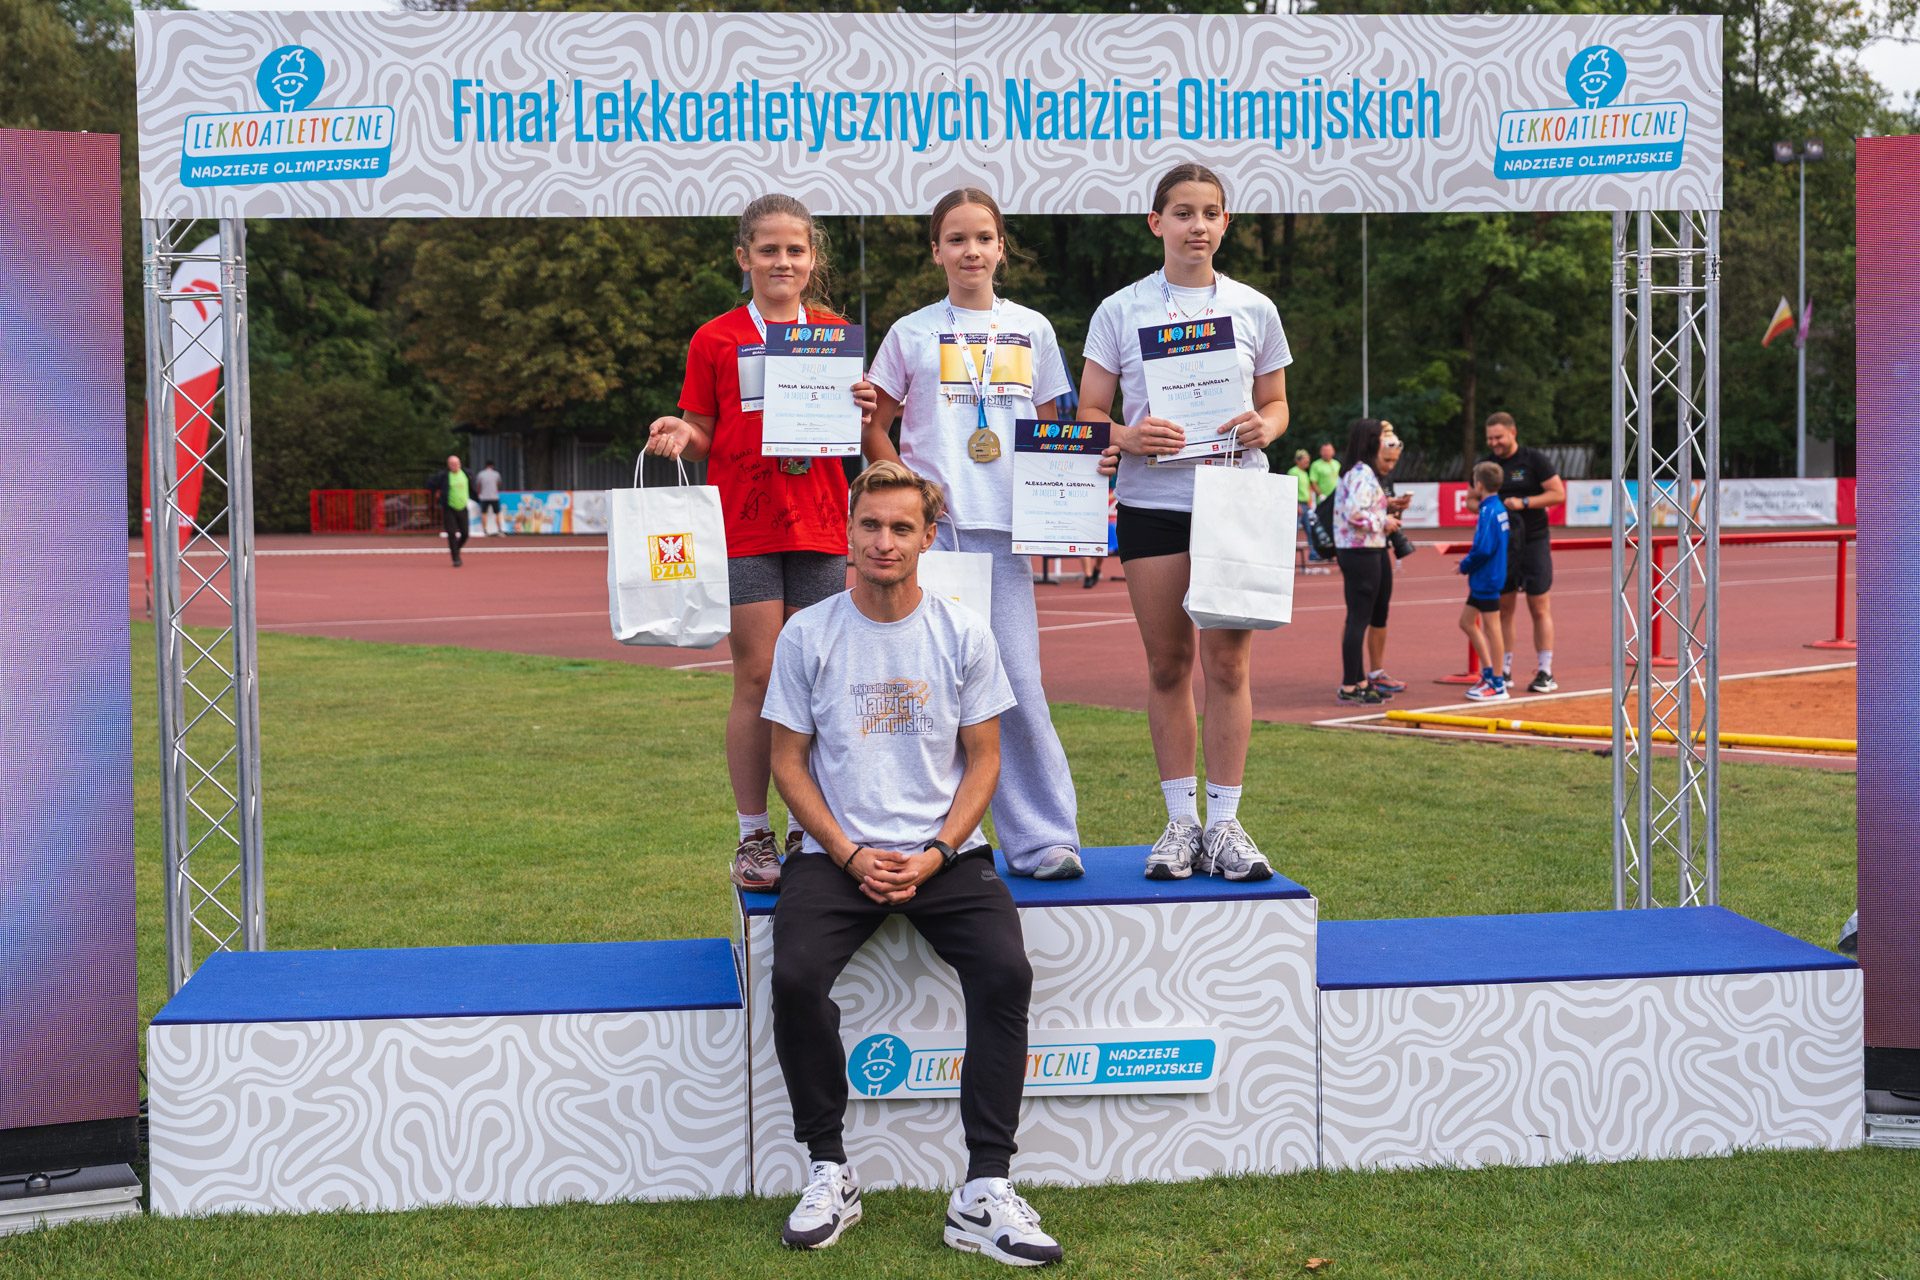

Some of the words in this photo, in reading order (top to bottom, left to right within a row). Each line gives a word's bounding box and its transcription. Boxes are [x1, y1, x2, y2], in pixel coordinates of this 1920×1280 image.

[453, 79, 559, 142] Finał
[574, 79, 988, 152] Lekkoatletycznych
[1006, 79, 1161, 140] Nadziei
[1178, 78, 1440, 150] Olimpijskich
[193, 115, 384, 149] LEKKOATLETYCZNE
[1507, 111, 1677, 144] LEKKOATLETYCZNE
[191, 162, 269, 178] NADZIEJE
[273, 157, 379, 174] OLIMPIJSKIE
[1504, 156, 1574, 172] NADZIEJE
[1578, 151, 1673, 168] OLIMPIJSKIE
[812, 327, 846, 342] FINAŁ
[1185, 322, 1217, 339] FINAŁ
[1195, 342, 1211, 351] 2025
[1060, 424, 1093, 439] FINAŁ
[1068, 444, 1084, 452] 2025
[653, 564, 693, 578] PZLA
[850, 683, 909, 695] Lekkoatletyczne
[855, 693, 924, 716] Nadzieje
[863, 714, 934, 735] Olimpijskie
[1109, 1047, 1180, 1061] NADZIEJE
[915, 1052, 1091, 1082] LEKKTYCZNE
[1106, 1062, 1204, 1077] OLIMPIJSKIE
